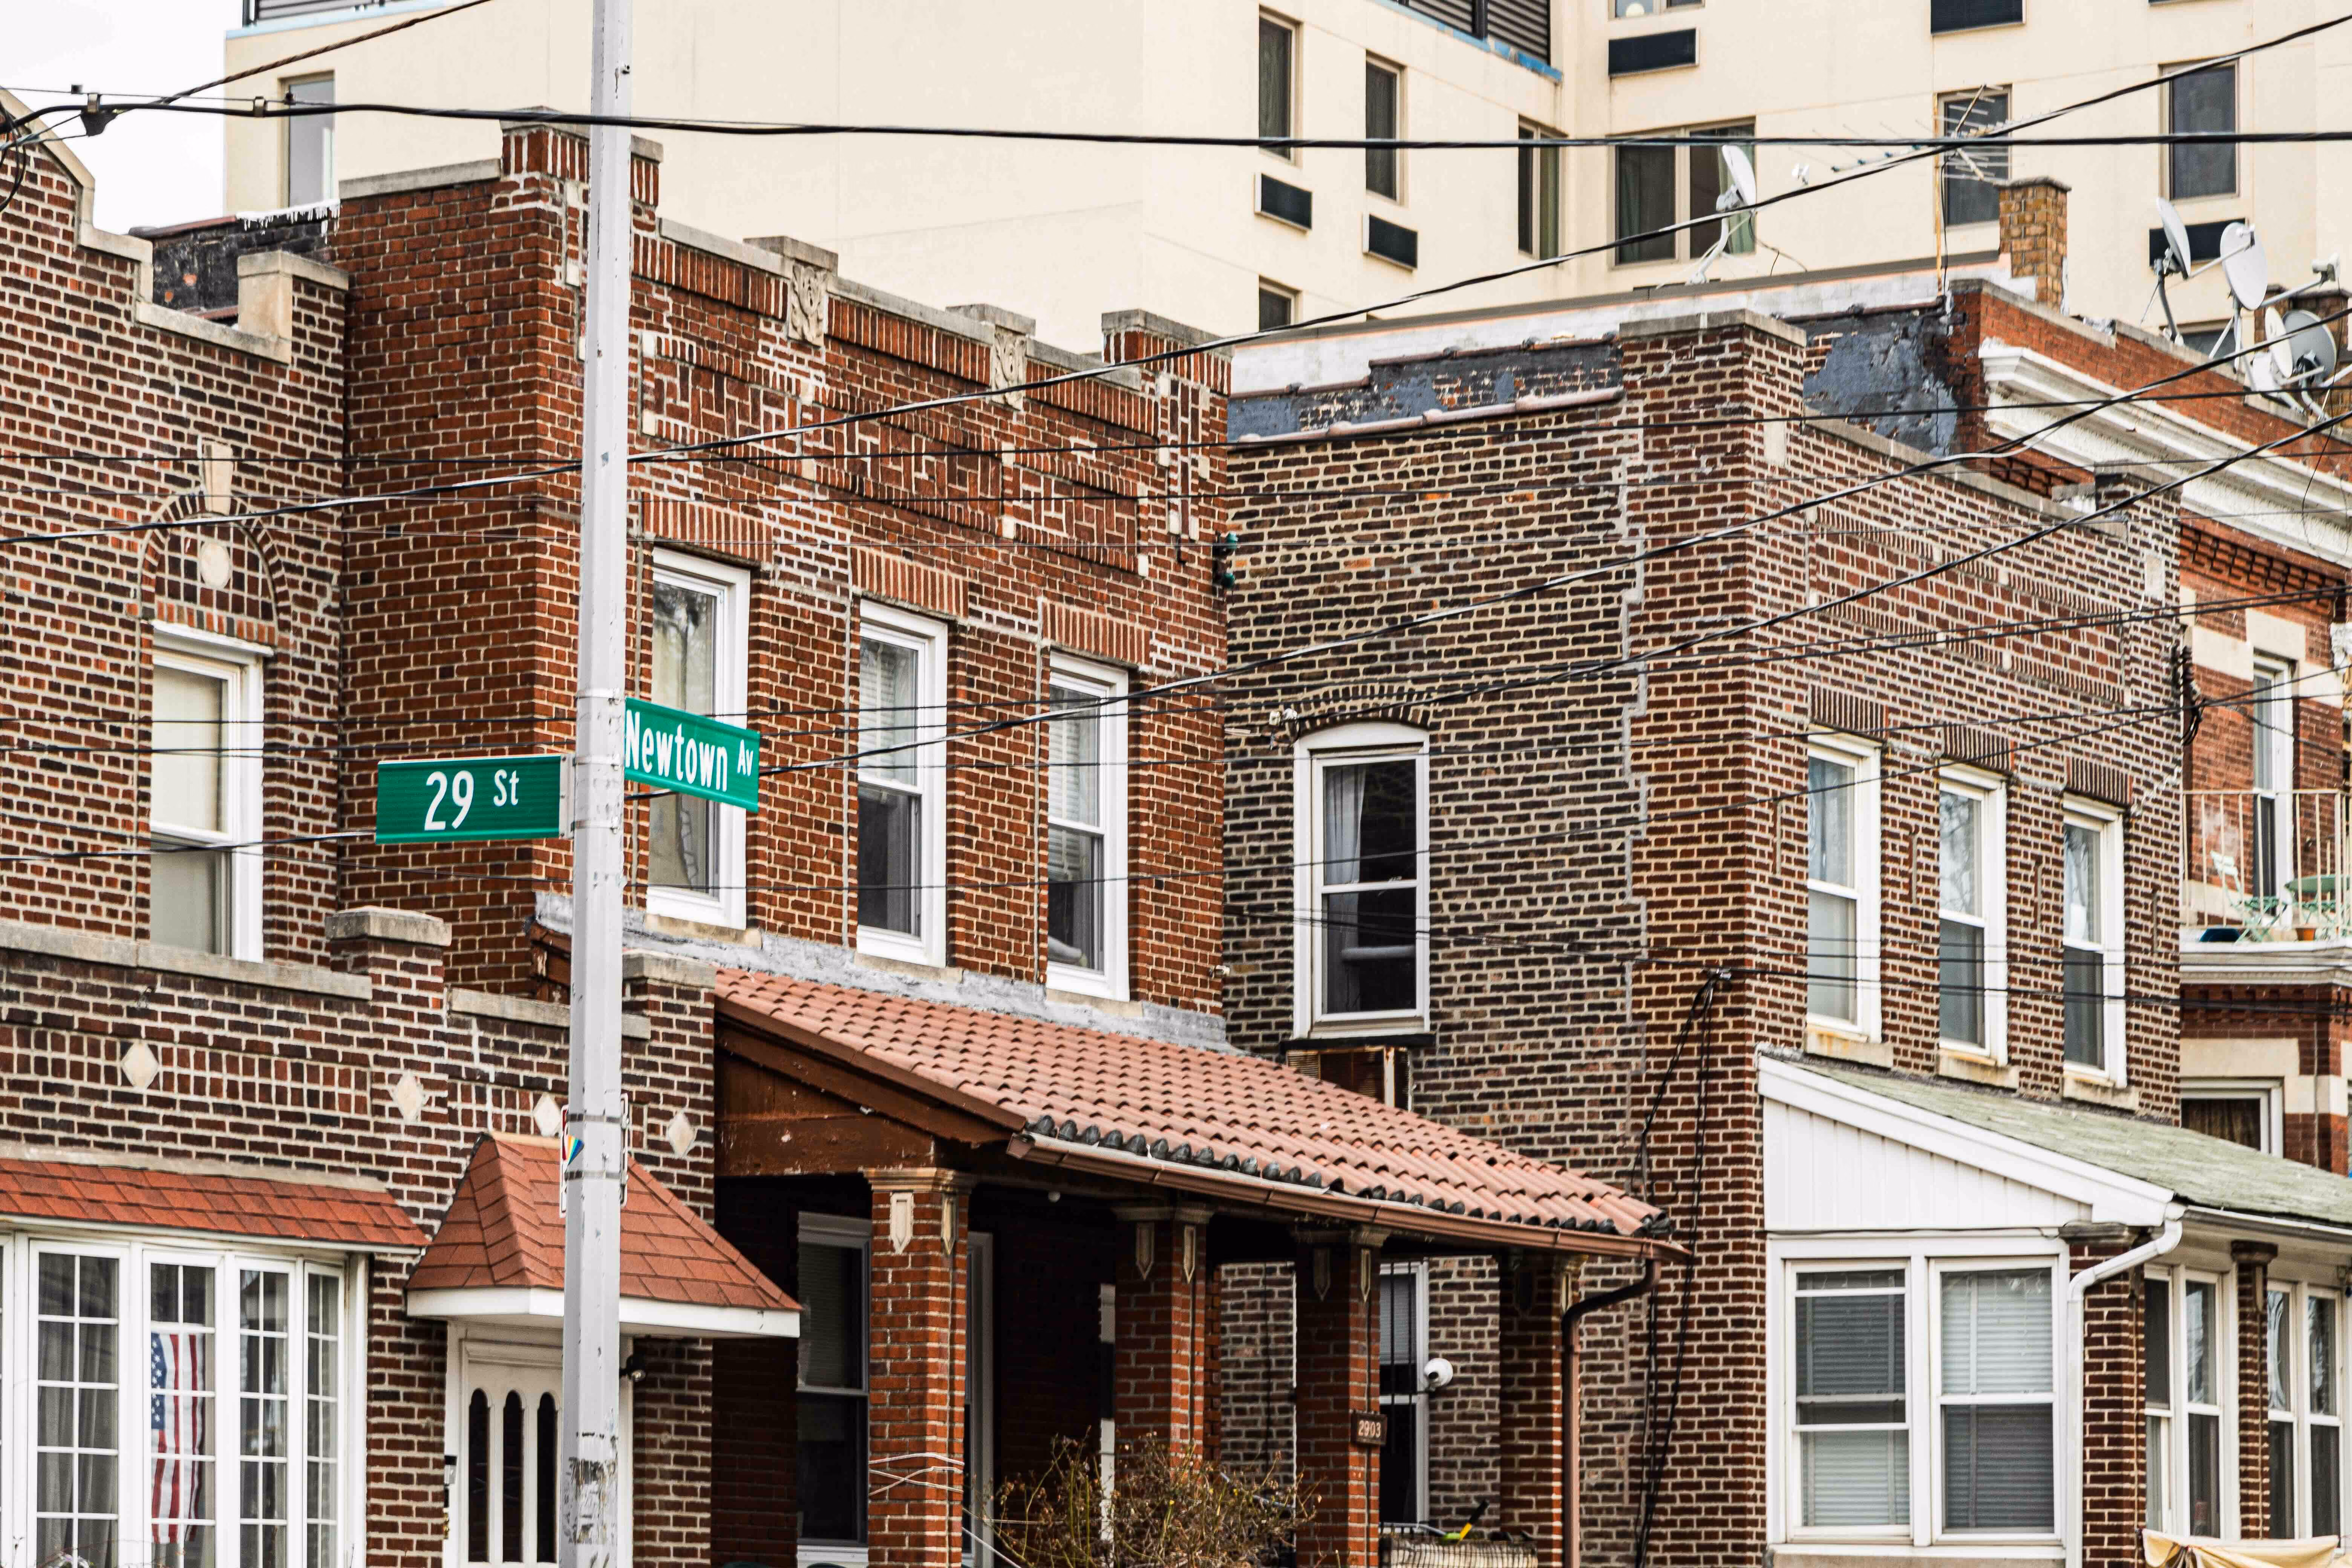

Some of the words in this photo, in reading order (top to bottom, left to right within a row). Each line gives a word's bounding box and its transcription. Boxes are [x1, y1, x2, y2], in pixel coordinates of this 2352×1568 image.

[625, 710, 727, 792] Newtown
[737, 739, 753, 776] Av
[424, 770, 474, 831] 29
[493, 769, 519, 807] St
[1358, 1420, 1381, 1438] 2903
